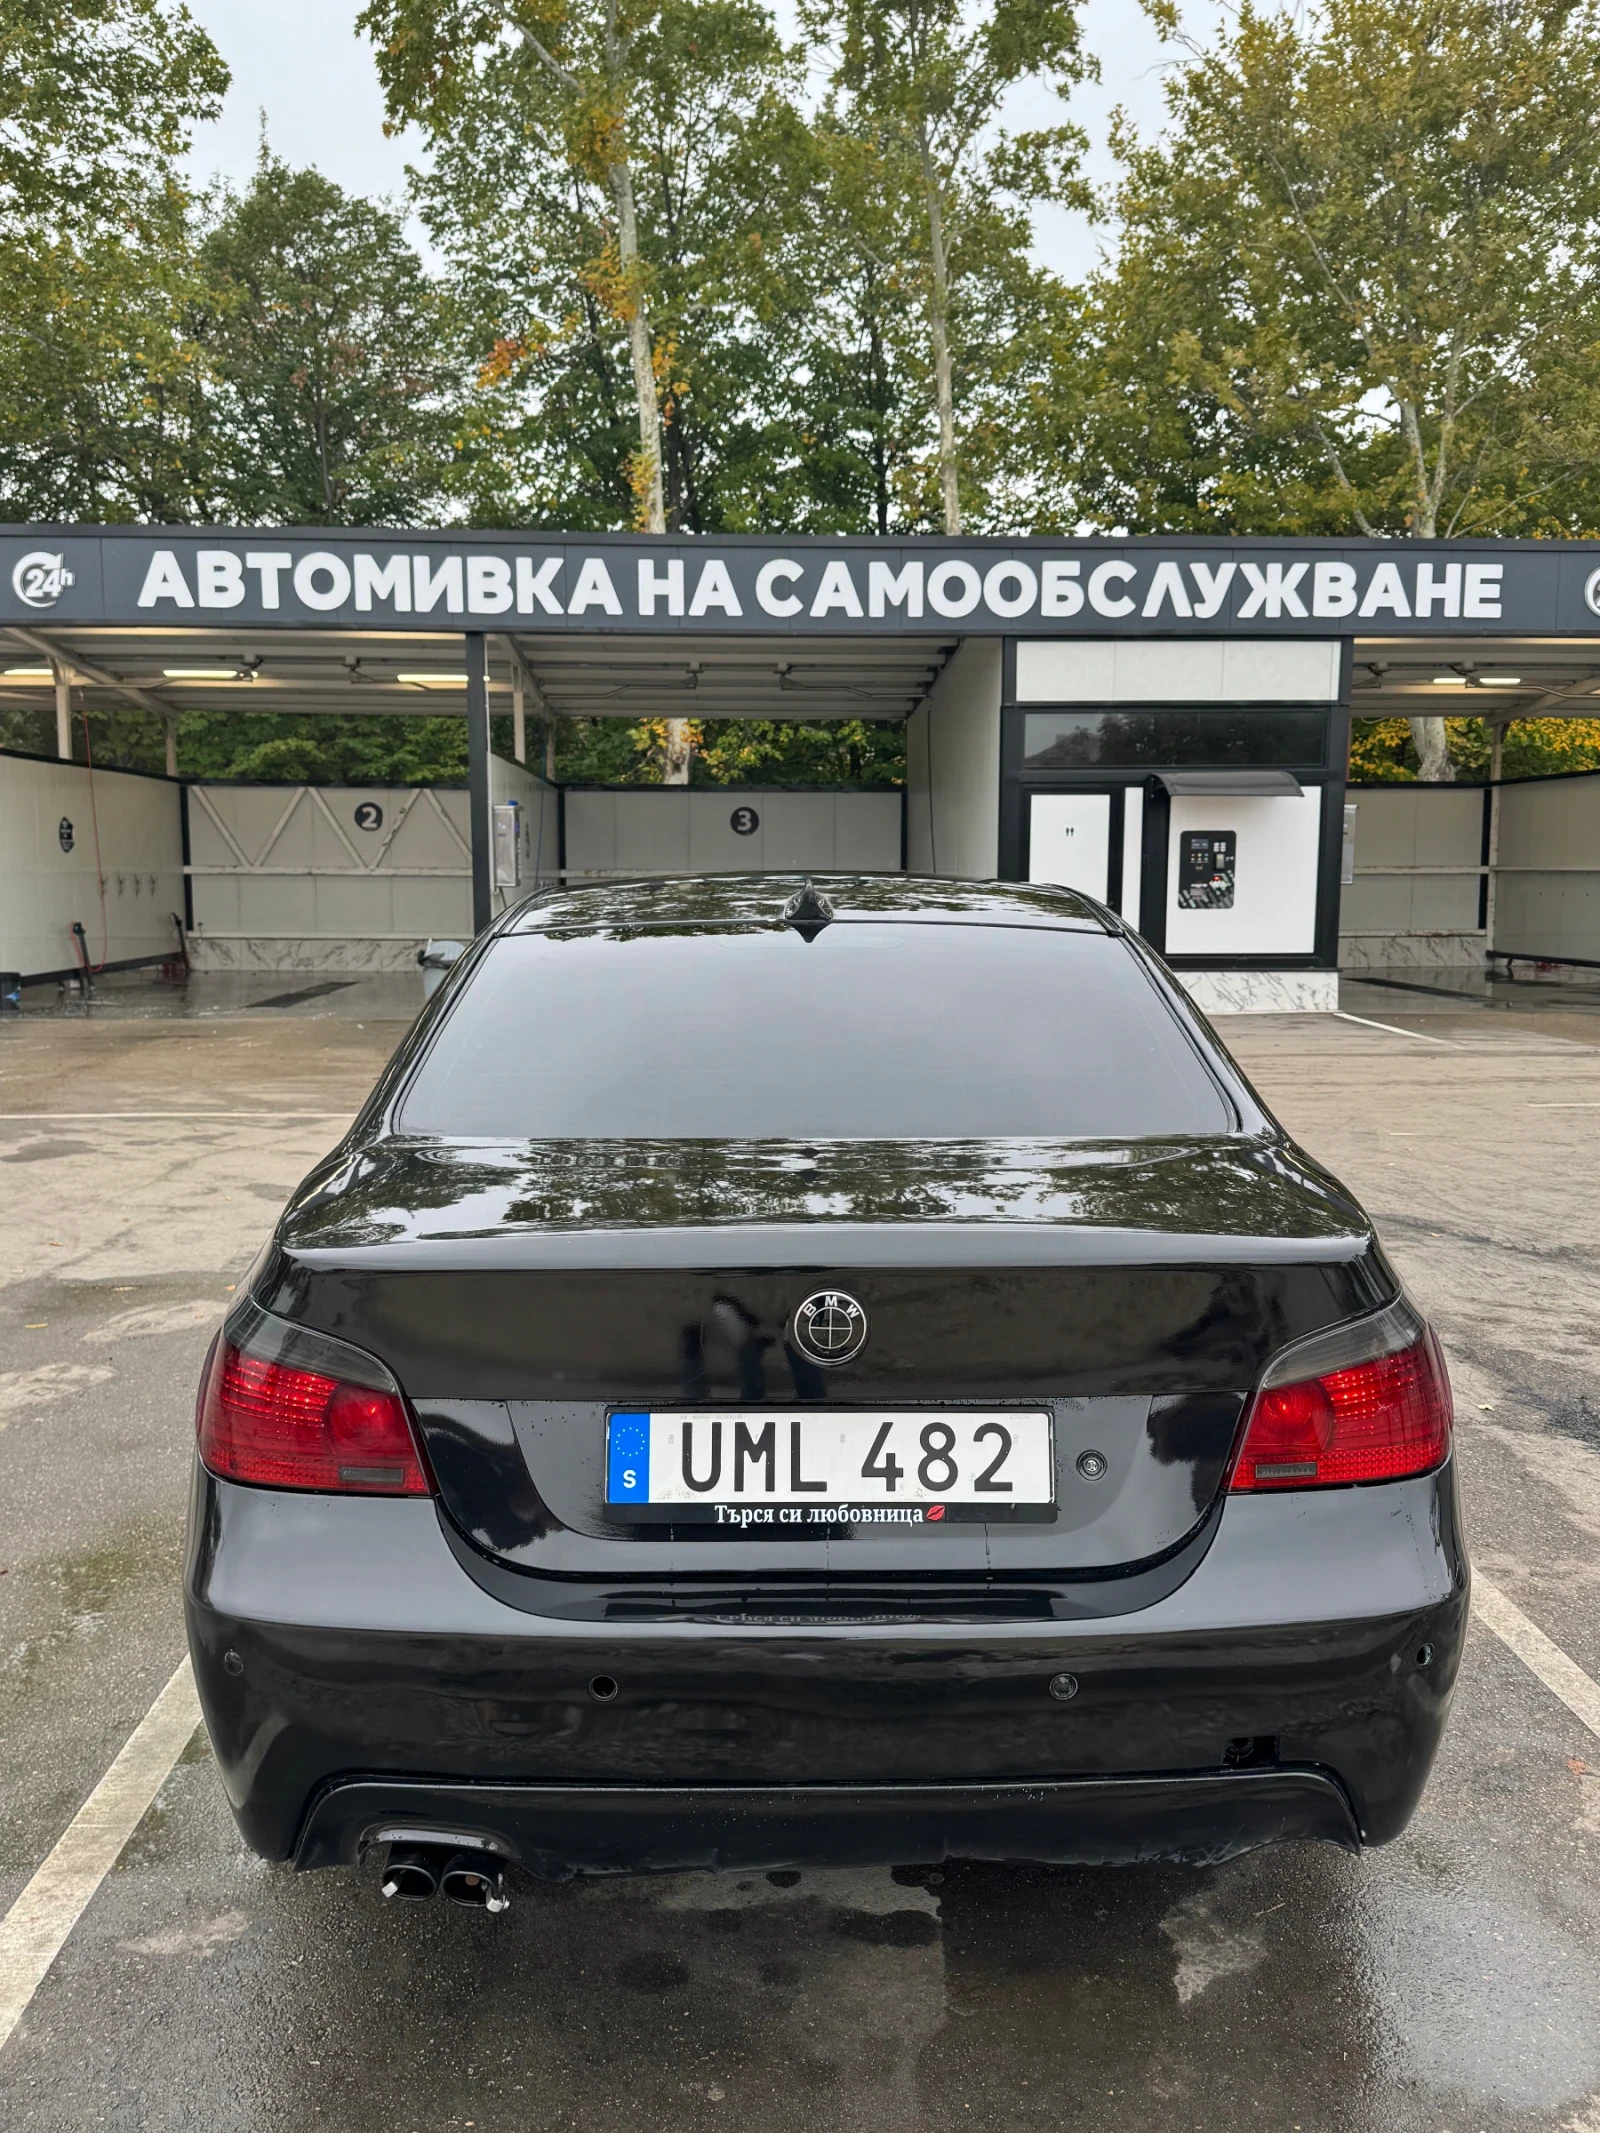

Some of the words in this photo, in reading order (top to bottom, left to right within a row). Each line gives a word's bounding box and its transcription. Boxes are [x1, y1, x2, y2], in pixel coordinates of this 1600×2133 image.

[25, 567, 75, 598] 24h
[137, 550, 624, 616] АВТОМИВКА
[637, 558, 744, 617] НА
[755, 558, 1504, 619] САМООБСЛУЖВАНЕ
[362, 806, 378, 828] 2
[737, 810, 752, 832] 3
[802, 1295, 860, 1319] BMW
[682, 1421, 828, 1493] UML
[861, 1421, 1013, 1493] 482
[622, 1469, 637, 1489] S
[714, 1504, 774, 1529] Търся
[778, 1507, 803, 1524] си
[806, 1503, 924, 1528] любовница
